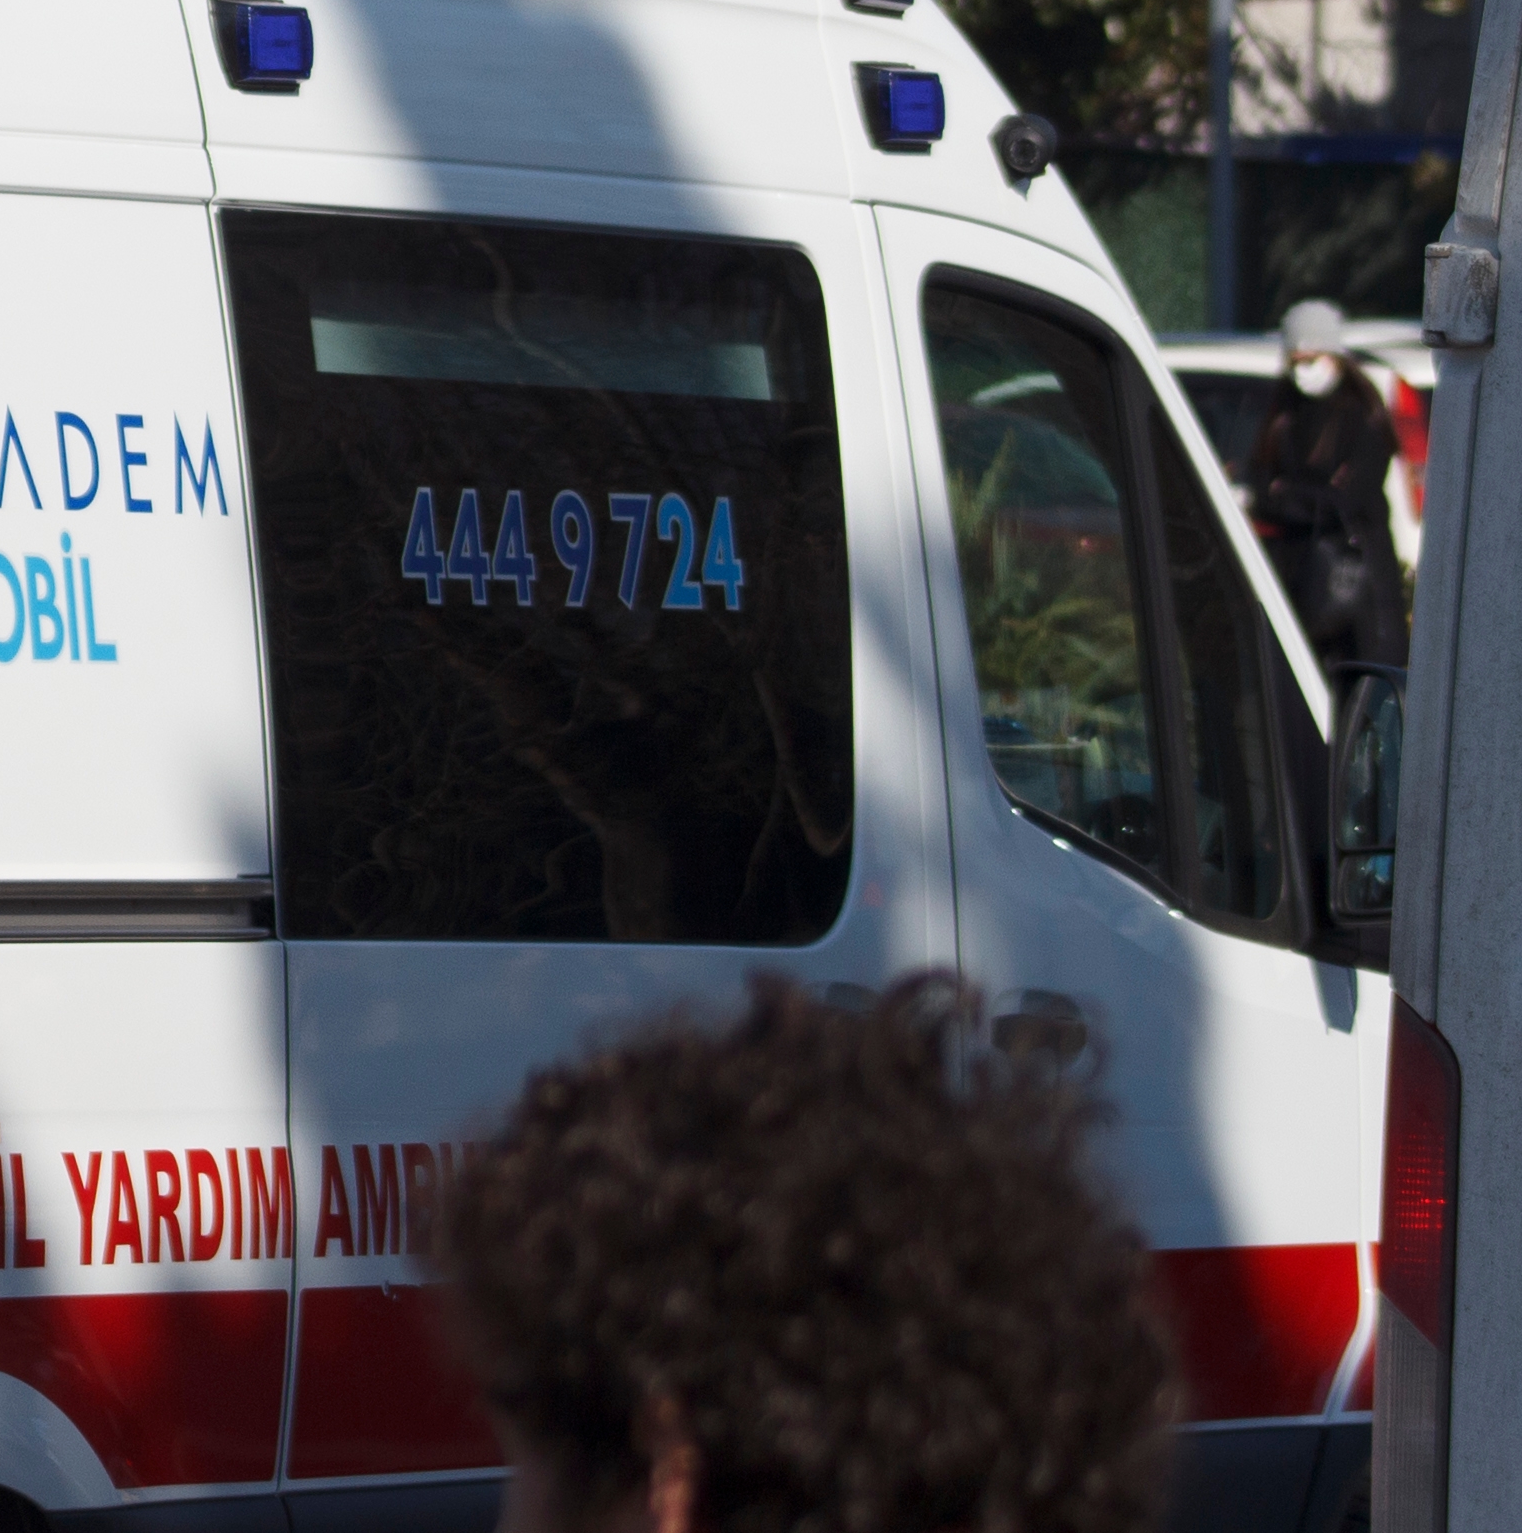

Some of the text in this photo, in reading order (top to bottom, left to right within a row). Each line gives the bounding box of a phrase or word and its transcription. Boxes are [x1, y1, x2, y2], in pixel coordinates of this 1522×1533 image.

[401, 487, 745, 612] 444 9 724
[61, 1146, 294, 1266] YARDIM
